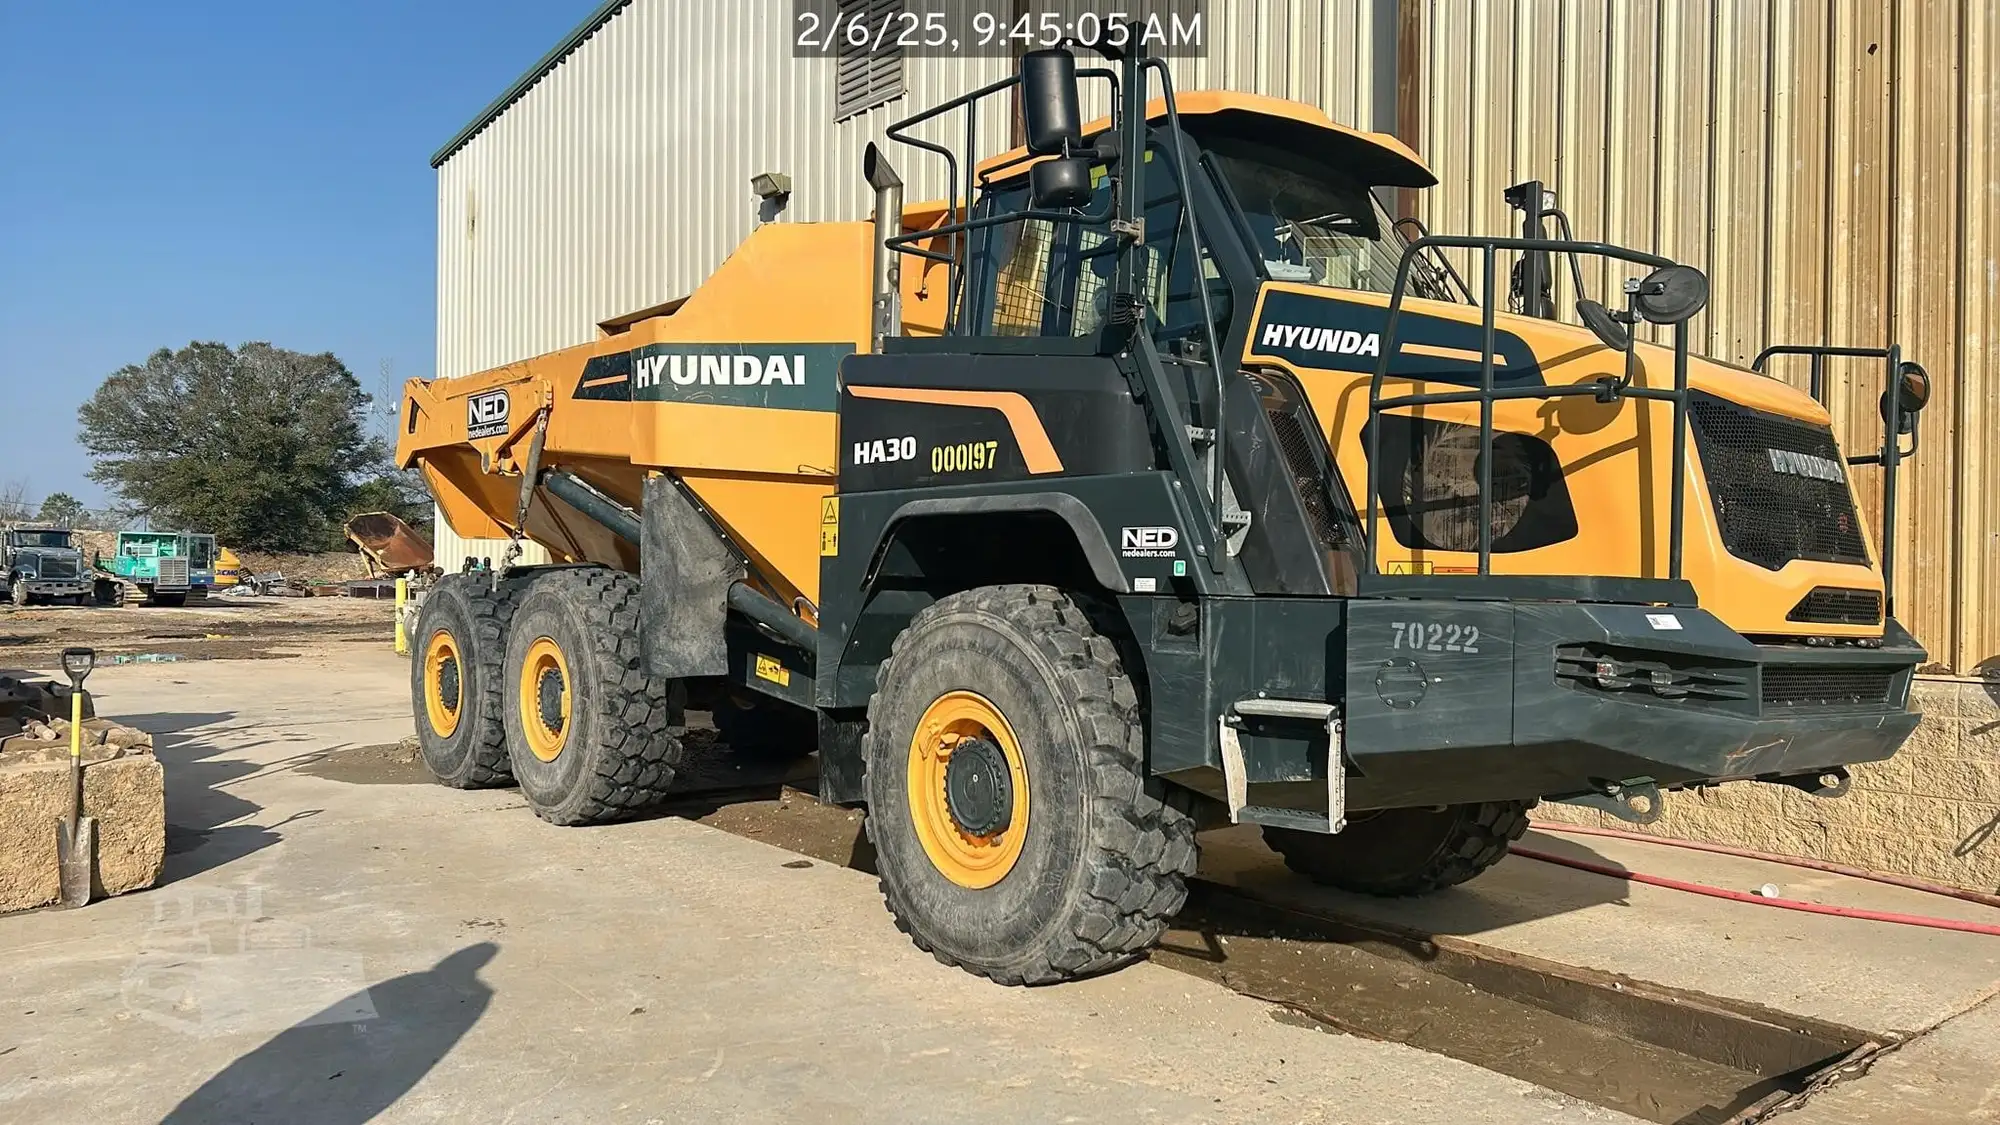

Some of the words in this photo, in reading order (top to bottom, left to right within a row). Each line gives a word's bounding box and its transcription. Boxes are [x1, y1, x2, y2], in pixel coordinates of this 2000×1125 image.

[636, 355, 806, 389] HYUNDAI
[468, 391, 509, 427] NED
[468, 424, 508, 439] nedealers.com
[854, 436, 917, 465] HA30
[931, 441, 998, 473] 000197
[1122, 527, 1178, 549] NED
[1122, 550, 1176, 558] nedealers.com
[1391, 622, 1479, 653] 70222
